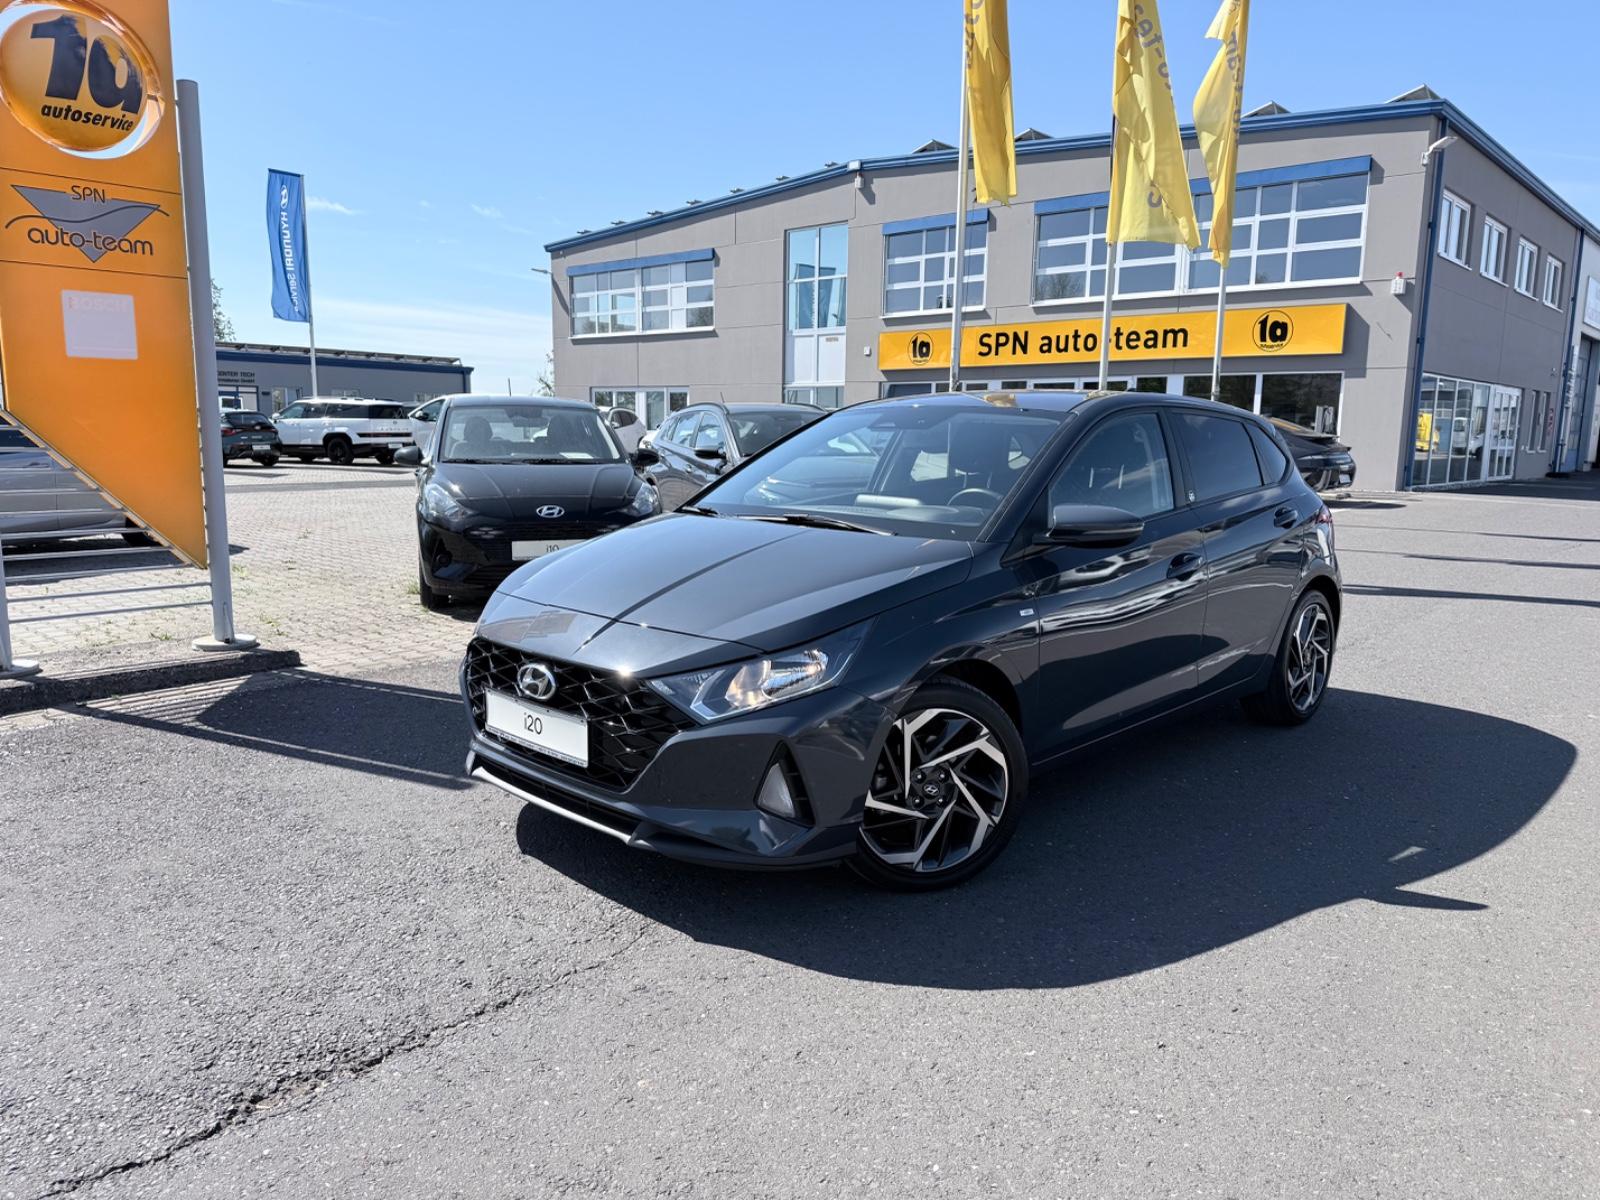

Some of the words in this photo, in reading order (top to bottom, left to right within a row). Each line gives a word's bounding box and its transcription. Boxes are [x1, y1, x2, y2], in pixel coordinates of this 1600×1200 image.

[40, 103, 134, 132] autoservice
[71, 185, 106, 204] SPN
[27, 226, 154, 256] auto-team
[1258, 314, 1288, 343] 1a
[911, 335, 931, 358] 1a
[977, 330, 1029, 357] SPN
[523, 711, 543, 735] i20
